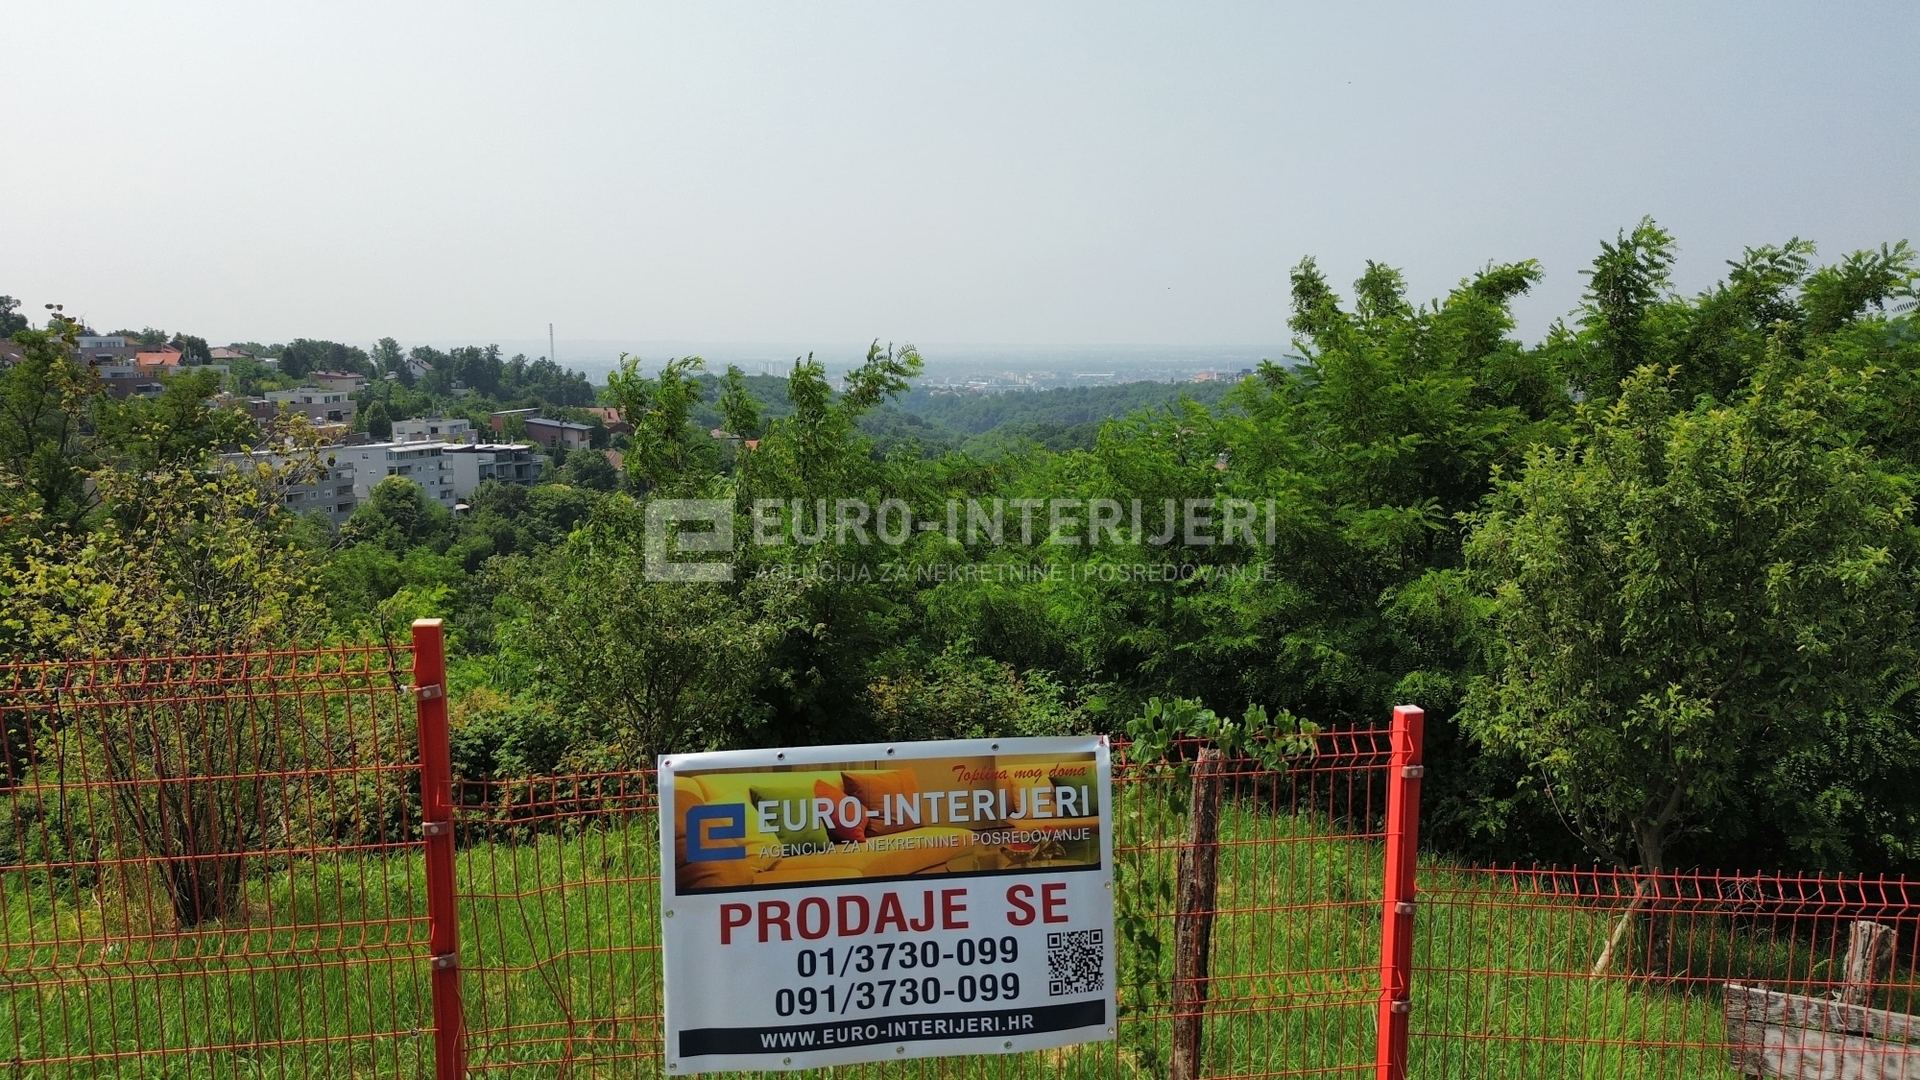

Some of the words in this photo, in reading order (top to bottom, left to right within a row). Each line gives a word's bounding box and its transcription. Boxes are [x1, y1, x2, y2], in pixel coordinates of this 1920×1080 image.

[952, 764, 1010, 783] Toplina
[1014, 767, 1045, 783] mog
[1048, 763, 1088, 778] doma
[757, 785, 1090, 833] EURO-INTERIJERI
[759, 843, 837, 859] AGENCIJA
[841, 841, 862, 854] ZA
[867, 835, 959, 852] NEKRETNINE
[963, 834, 968, 847] I
[971, 827, 1091, 846] POSREDOVANJE
[720, 888, 969, 945] PRODAJE
[1005, 883, 1069, 927] SE
[797, 935, 1019, 978] 01/3730-099
[775, 972, 1020, 1017] 091/3730-099
[760, 1014, 1035, 1049] WWW.EURO-INTERIJERI.HR
